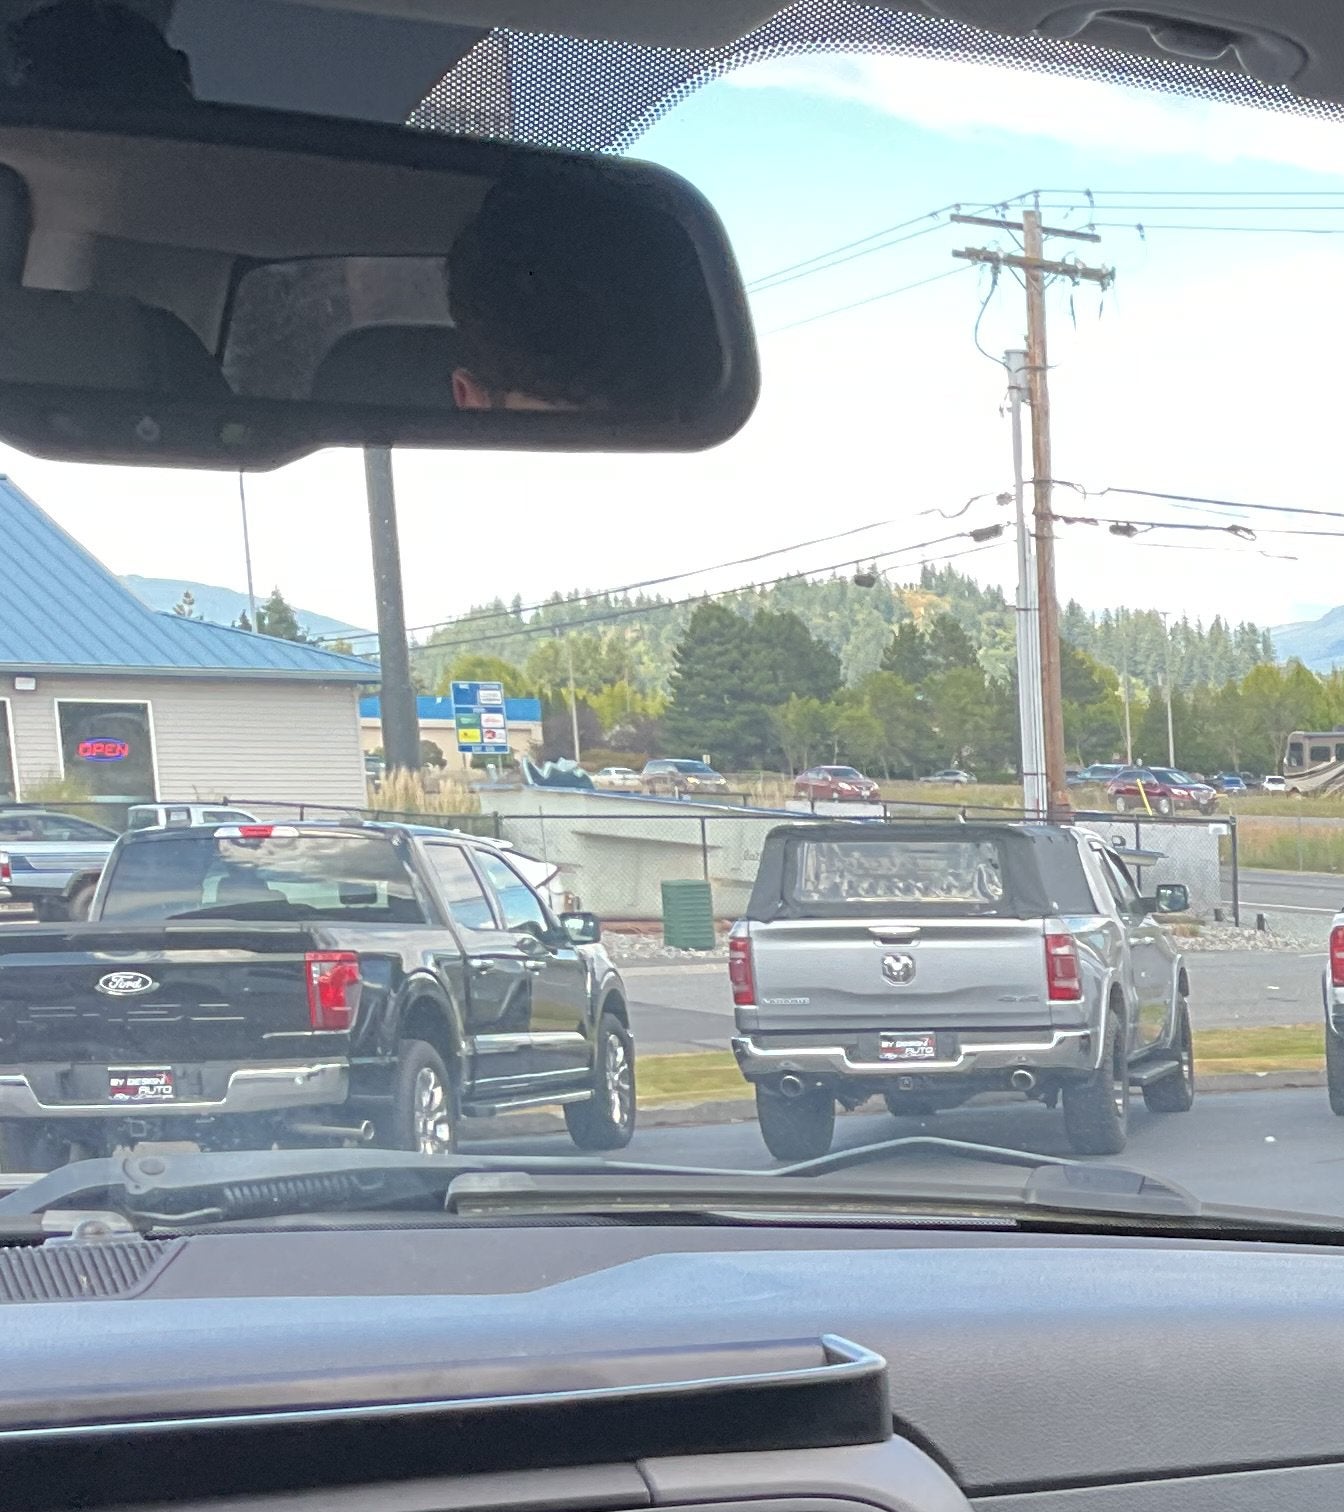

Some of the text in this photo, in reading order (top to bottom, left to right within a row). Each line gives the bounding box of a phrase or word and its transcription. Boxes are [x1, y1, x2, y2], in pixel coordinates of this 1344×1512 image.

[78, 742, 129, 757] OPEN
[108, 975, 143, 989] Ford
[904, 1046, 934, 1054] AUTO
[109, 1076, 165, 1087] BY DESIGN
[138, 1085, 173, 1096] AUTO
